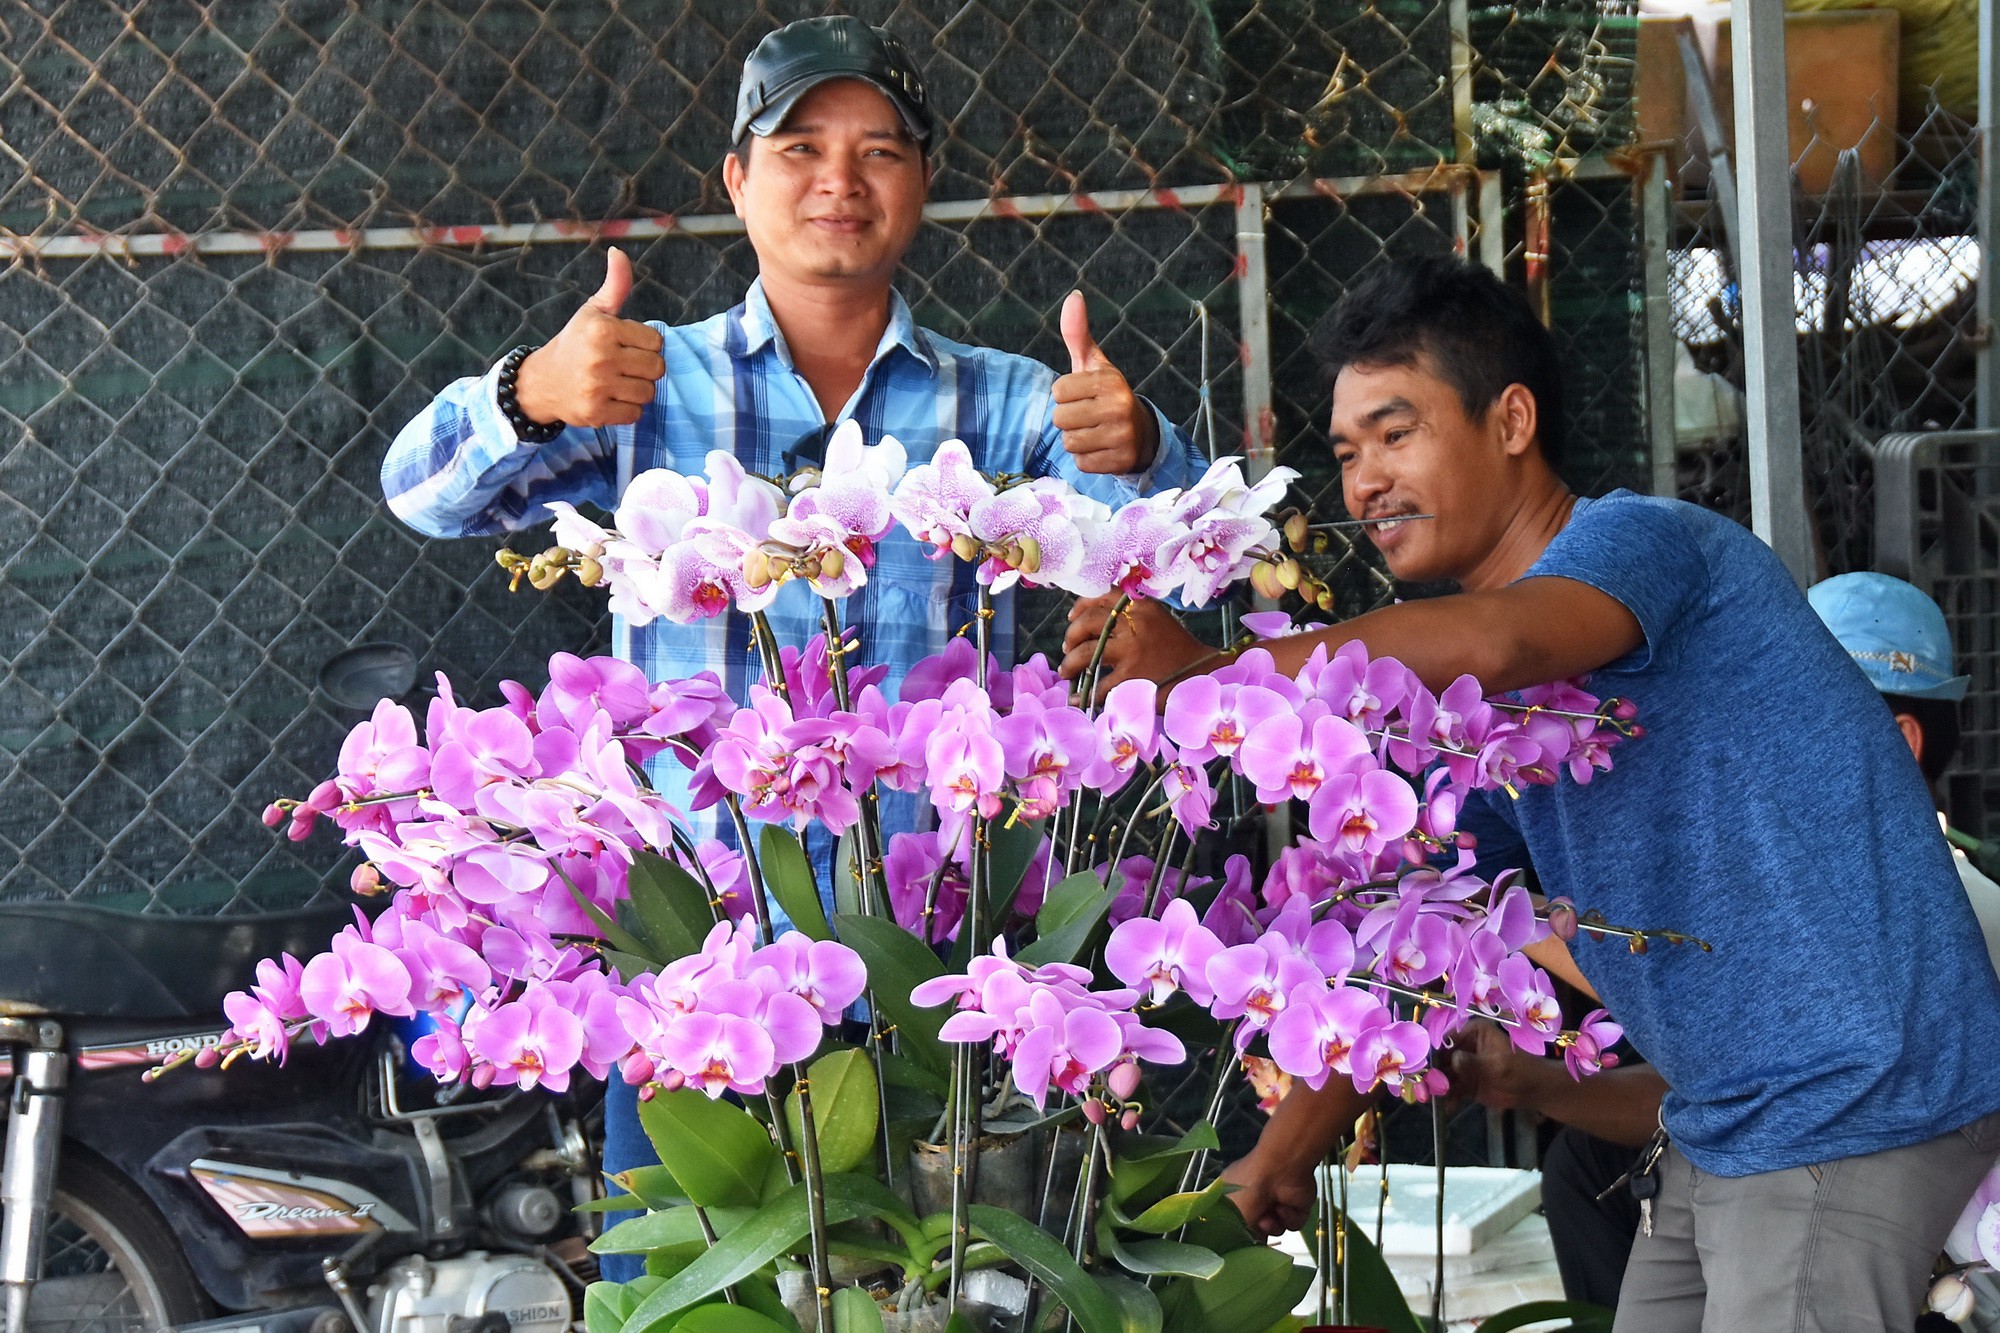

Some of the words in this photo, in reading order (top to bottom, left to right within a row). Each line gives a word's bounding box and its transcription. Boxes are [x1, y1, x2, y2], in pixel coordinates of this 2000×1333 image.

[146, 1035, 222, 1055] HOND
[236, 1202, 349, 1220] Dream
[351, 1203, 376, 1218] II
[508, 1306, 560, 1322] SHION
